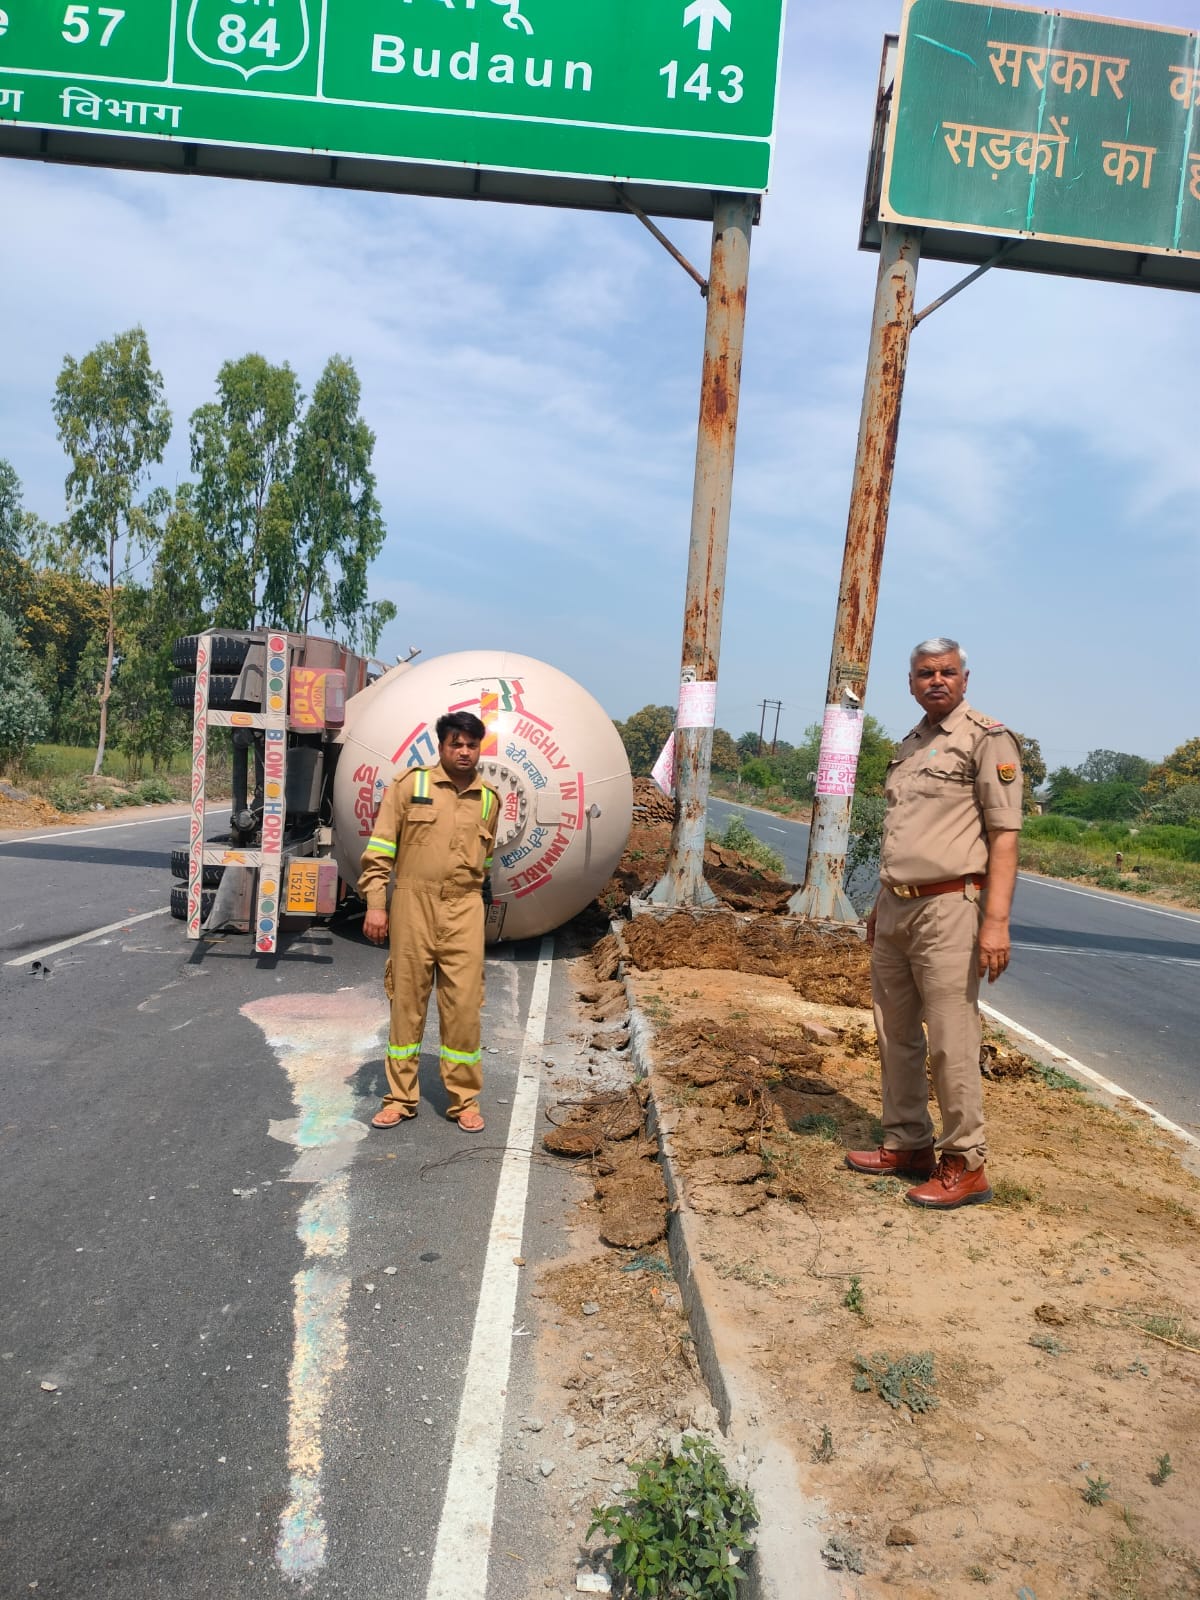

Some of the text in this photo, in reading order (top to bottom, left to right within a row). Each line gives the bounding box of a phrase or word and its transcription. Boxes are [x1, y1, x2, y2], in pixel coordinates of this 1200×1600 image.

[61, 5, 126, 47] 57
[217, 14, 281, 58] 84
[371, 33, 593, 91] Budaun
[659, 60, 745, 104] 143
[987, 40, 1130, 100] सरकार
[59, 86, 182, 128] विभाग
[942, 115, 1070, 181] सड़कों
[1101, 141, 1157, 189] का
[293, 669, 316, 725] STOP
[312, 686, 323, 707] NON
[262, 729, 285, 854] BLOW HORN
[504, 791, 518, 822] खतरा
[507, 719, 578, 891] HIGHLY IN FLAMMABLE
